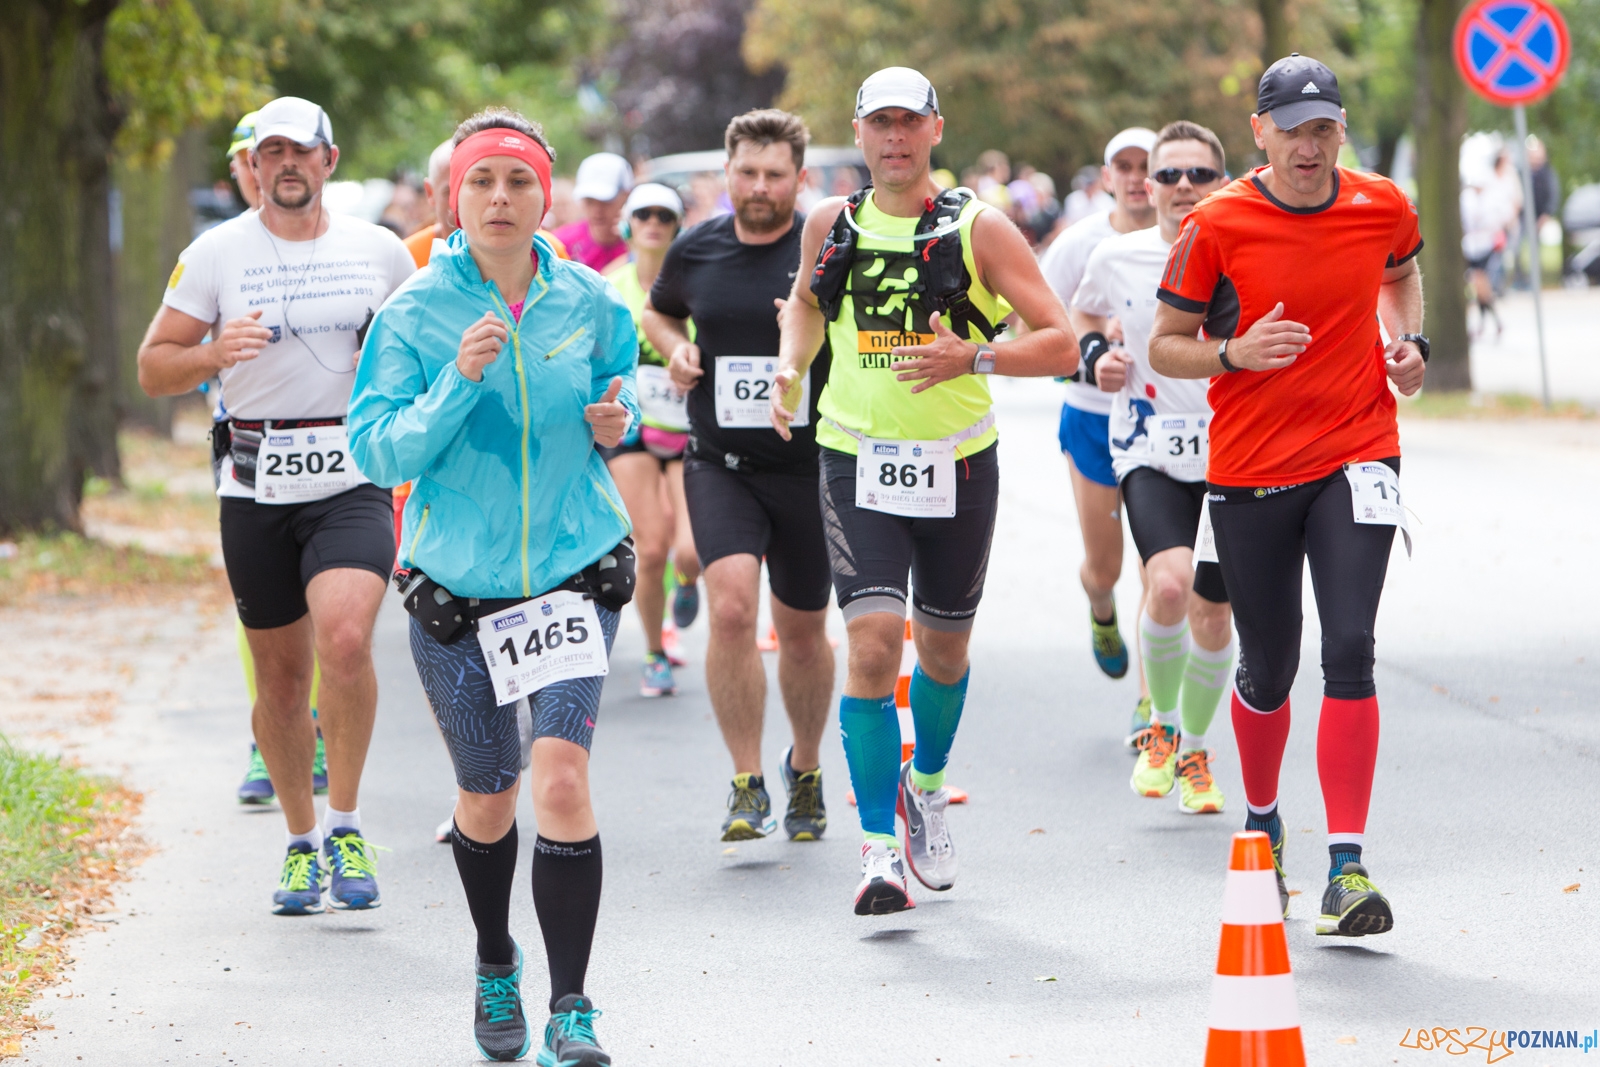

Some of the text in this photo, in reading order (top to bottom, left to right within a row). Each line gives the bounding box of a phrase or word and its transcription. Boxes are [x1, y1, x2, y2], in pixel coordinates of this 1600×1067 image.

[244, 259, 370, 277] XXXV Międzynarodowy
[240, 281, 263, 293] Bieg
[266, 276, 306, 287] Uliczny
[292, 324, 331, 335] Miasto
[734, 379, 775, 400] 62
[1168, 434, 1209, 456] 31
[265, 450, 346, 476] 2502
[878, 462, 935, 488] 861
[499, 617, 589, 666] 1465
[531, 661, 548, 676] BIEG
